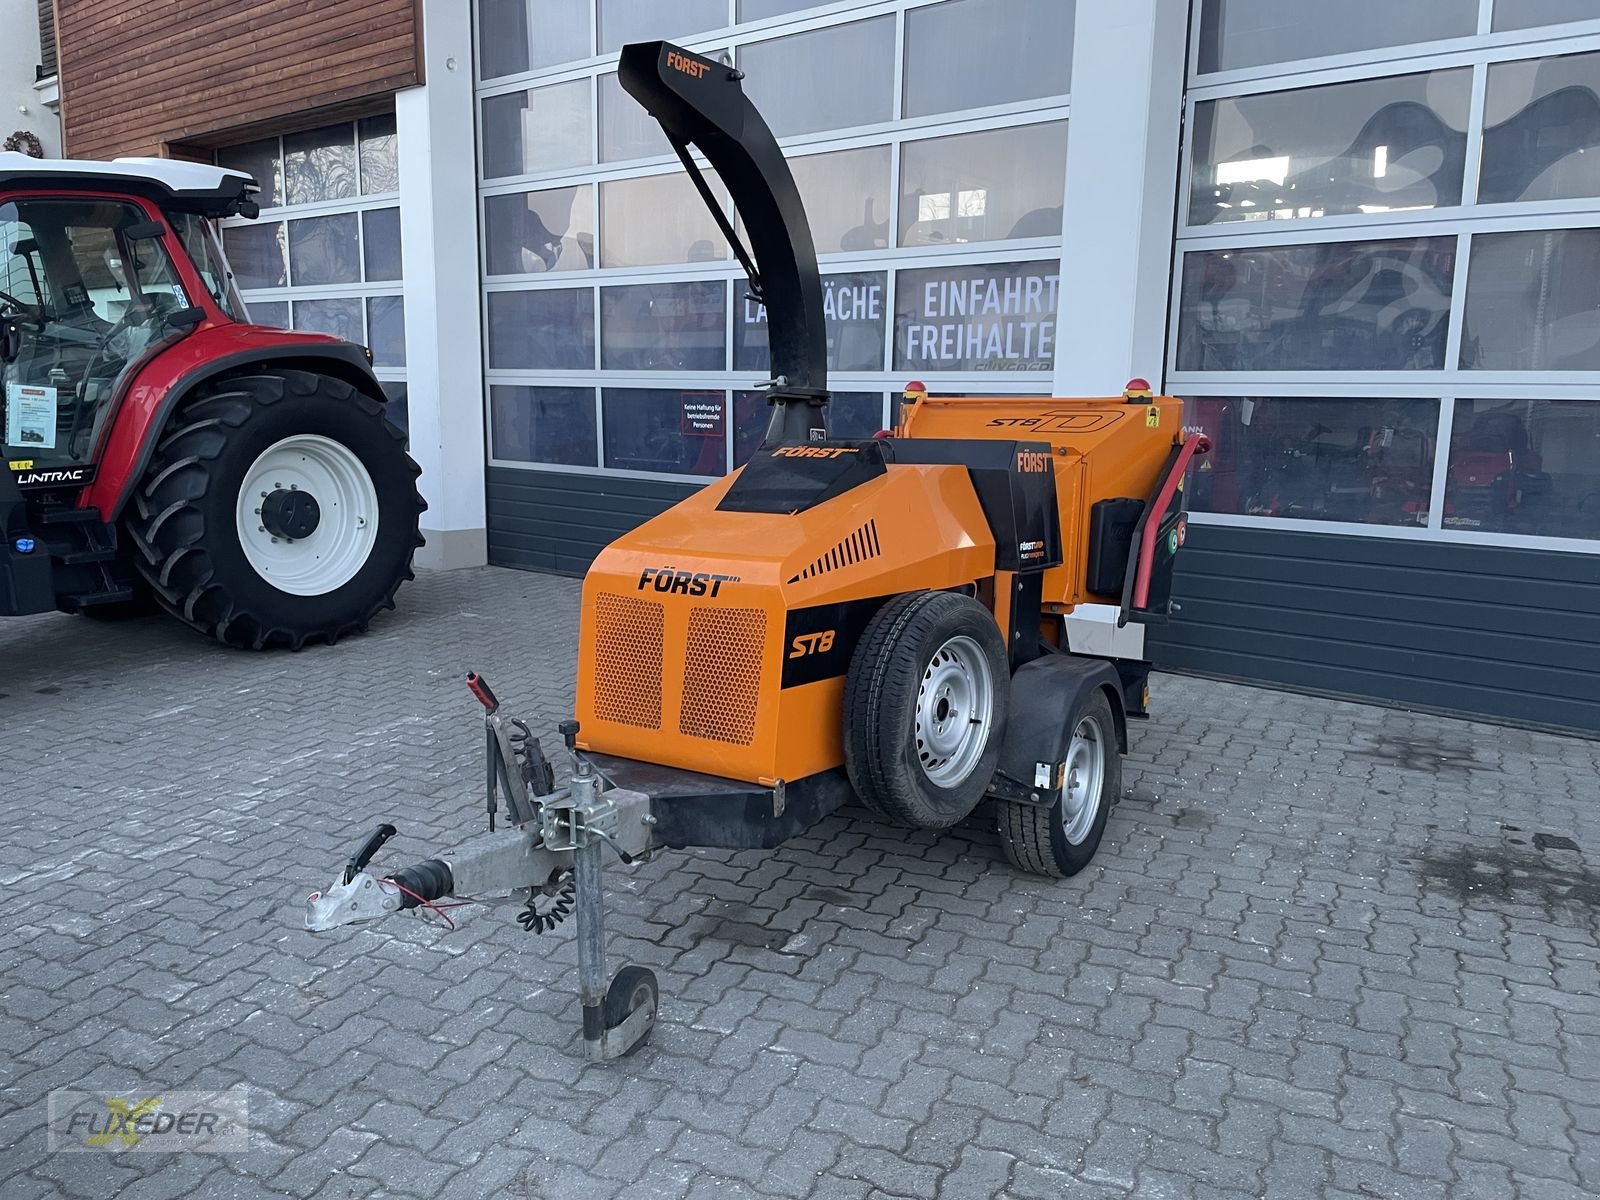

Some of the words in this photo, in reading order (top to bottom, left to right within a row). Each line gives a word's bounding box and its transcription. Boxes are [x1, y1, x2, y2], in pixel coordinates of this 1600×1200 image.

[666, 51, 711, 79] FÖRST
[924, 275, 1059, 317] EINFAHRT
[697, 404, 714, 412] Haftung
[772, 445, 860, 459] FÖRST
[1017, 449, 1050, 473] FÖRST
[17, 470, 84, 484] LINTRAC
[637, 565, 741, 598] FÖRST
[788, 630, 836, 659] ST8
